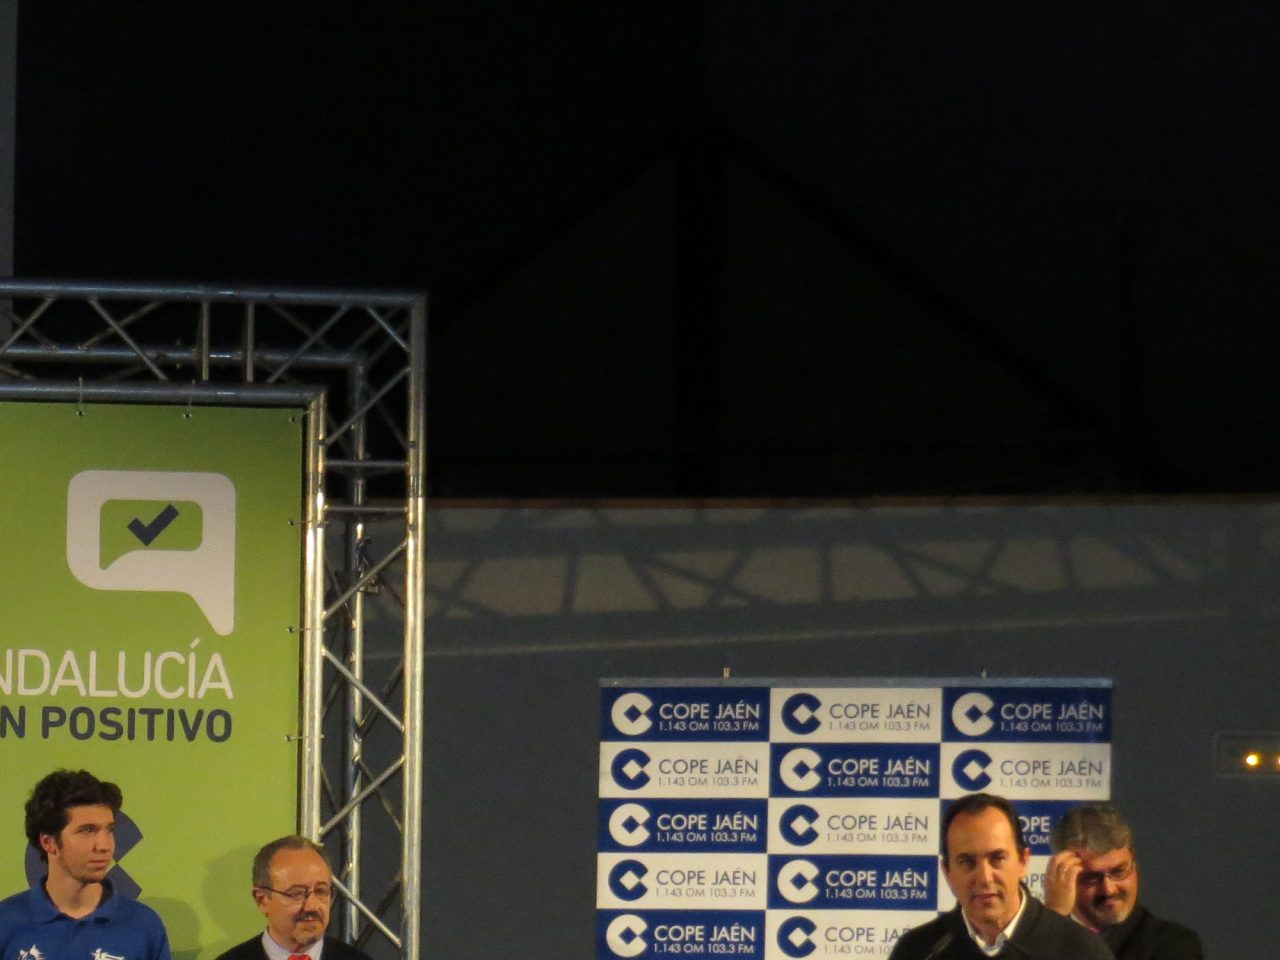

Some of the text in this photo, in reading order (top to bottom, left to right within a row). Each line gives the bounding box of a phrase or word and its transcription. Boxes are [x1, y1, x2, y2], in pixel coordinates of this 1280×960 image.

[659, 699, 760, 719] COPE JAÉN
[829, 700, 930, 719] COPE JAÉN
[1001, 700, 1103, 720] COPE JAÉN
[41, 706, 233, 743] POSITIVO
[659, 721, 759, 731] 1.143 OM 103.3 FM
[830, 721, 930, 731] 1.143 OM 103.3 FM
[1001, 722, 1102, 732] 1.143 OM 103.3 FM
[658, 755, 758, 775] COPE JAÉN
[828, 756, 930, 775] COPE JAÉN
[1000, 756, 1102, 776] COPE JAÉN
[658, 776, 758, 786] 1.143 OM 103.3 FM
[828, 777, 929, 787] 1.143 OM 103.3 FM
[1000, 778, 1101, 787] 1.143 OM 103.3 FM
[657, 811, 757, 830] COPE JAÉN
[827, 812, 928, 830] COPE JAÉN
[657, 832, 757, 842] 1.143 OM 103.3 FM
[827, 833, 927, 843] 1.143 OM 103.3 FM
[1029, 834, 1049, 844] OM
[656, 867, 756, 886] COPE JAÉN
[826, 868, 928, 887] COPE JAÉN
[656, 887, 755, 898] 1.143 OM 103.3 FM
[826, 888, 927, 899] 1.143 OM 103.3 FM
[654, 923, 755, 941] COPE JAÉN
[824, 927, 875, 942] COPE
[654, 943, 754, 953] 1.143 OM 103.3 FM
[825, 945, 851, 953] 1.143
[854, 945, 875, 954] OM
